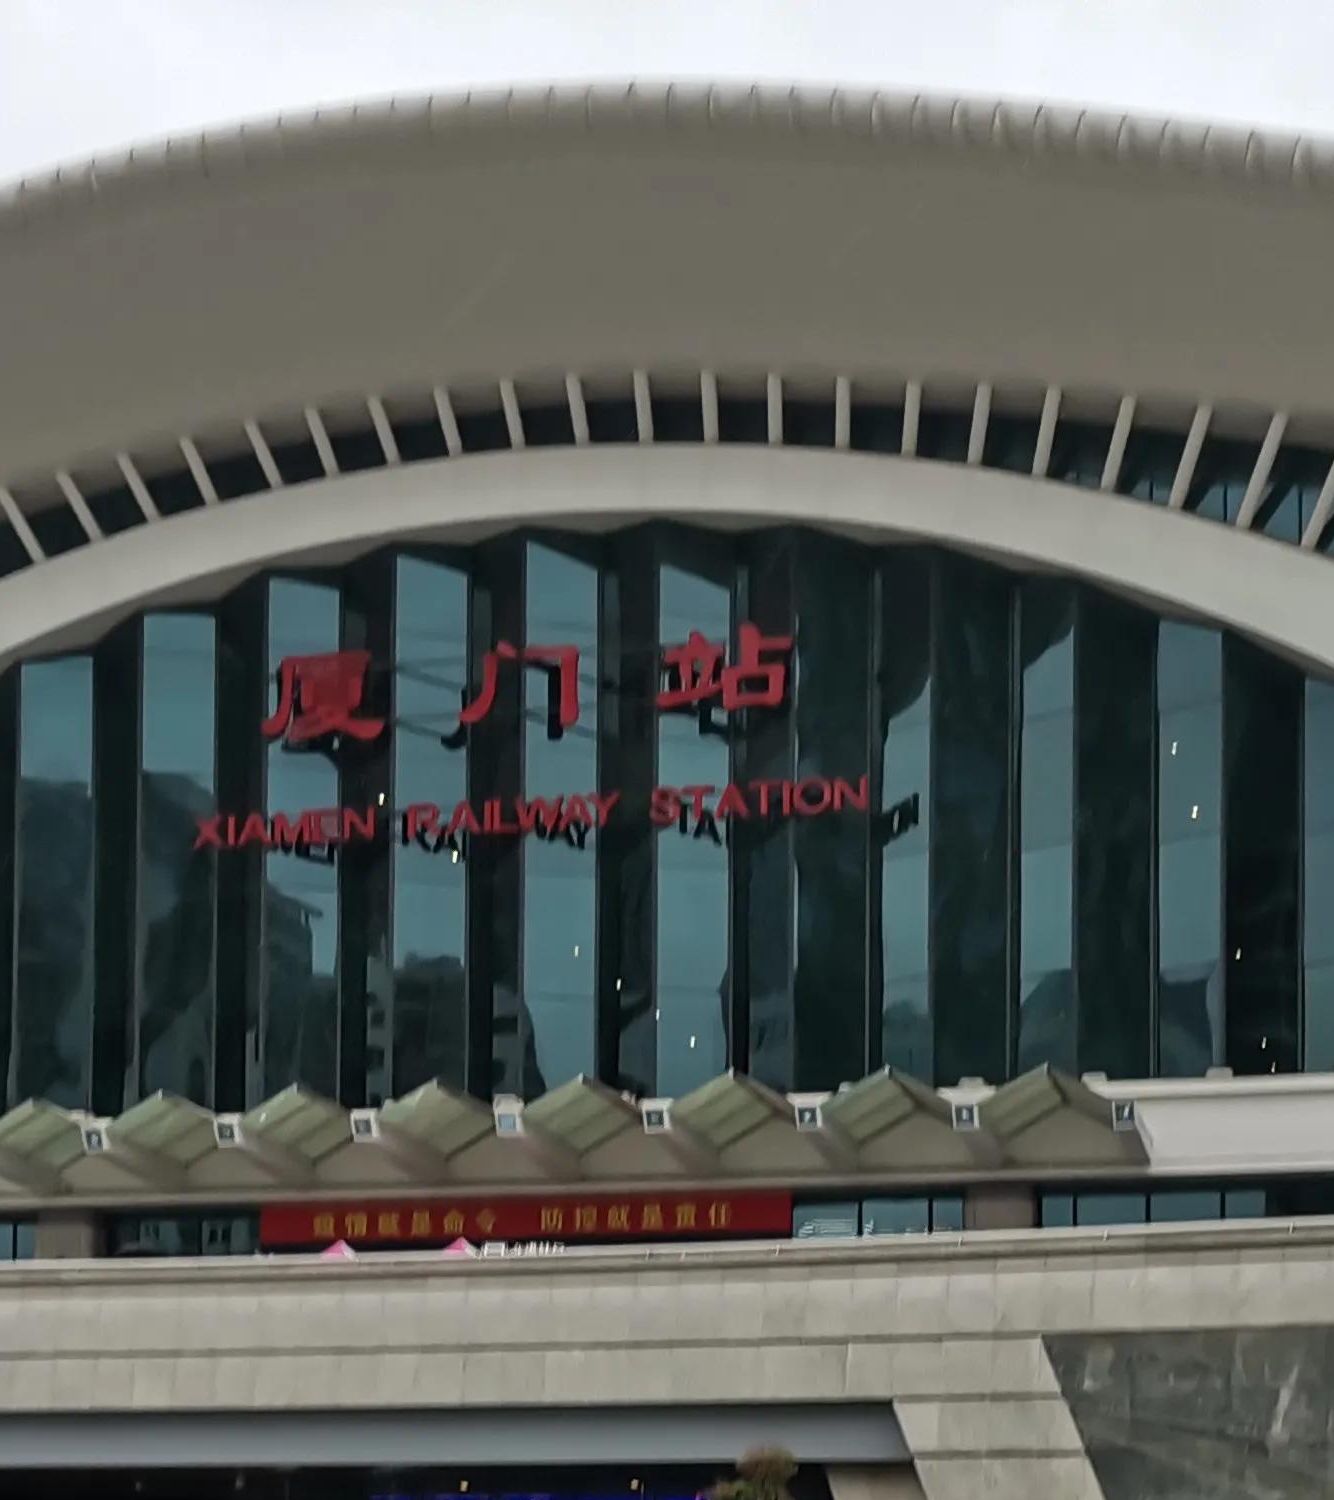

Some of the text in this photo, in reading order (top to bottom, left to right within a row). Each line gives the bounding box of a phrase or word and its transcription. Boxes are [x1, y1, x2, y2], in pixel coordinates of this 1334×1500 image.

[262, 621, 795, 741] 厦门站
[192, 774, 870, 850] XIAMEN RAILWAY STATION
